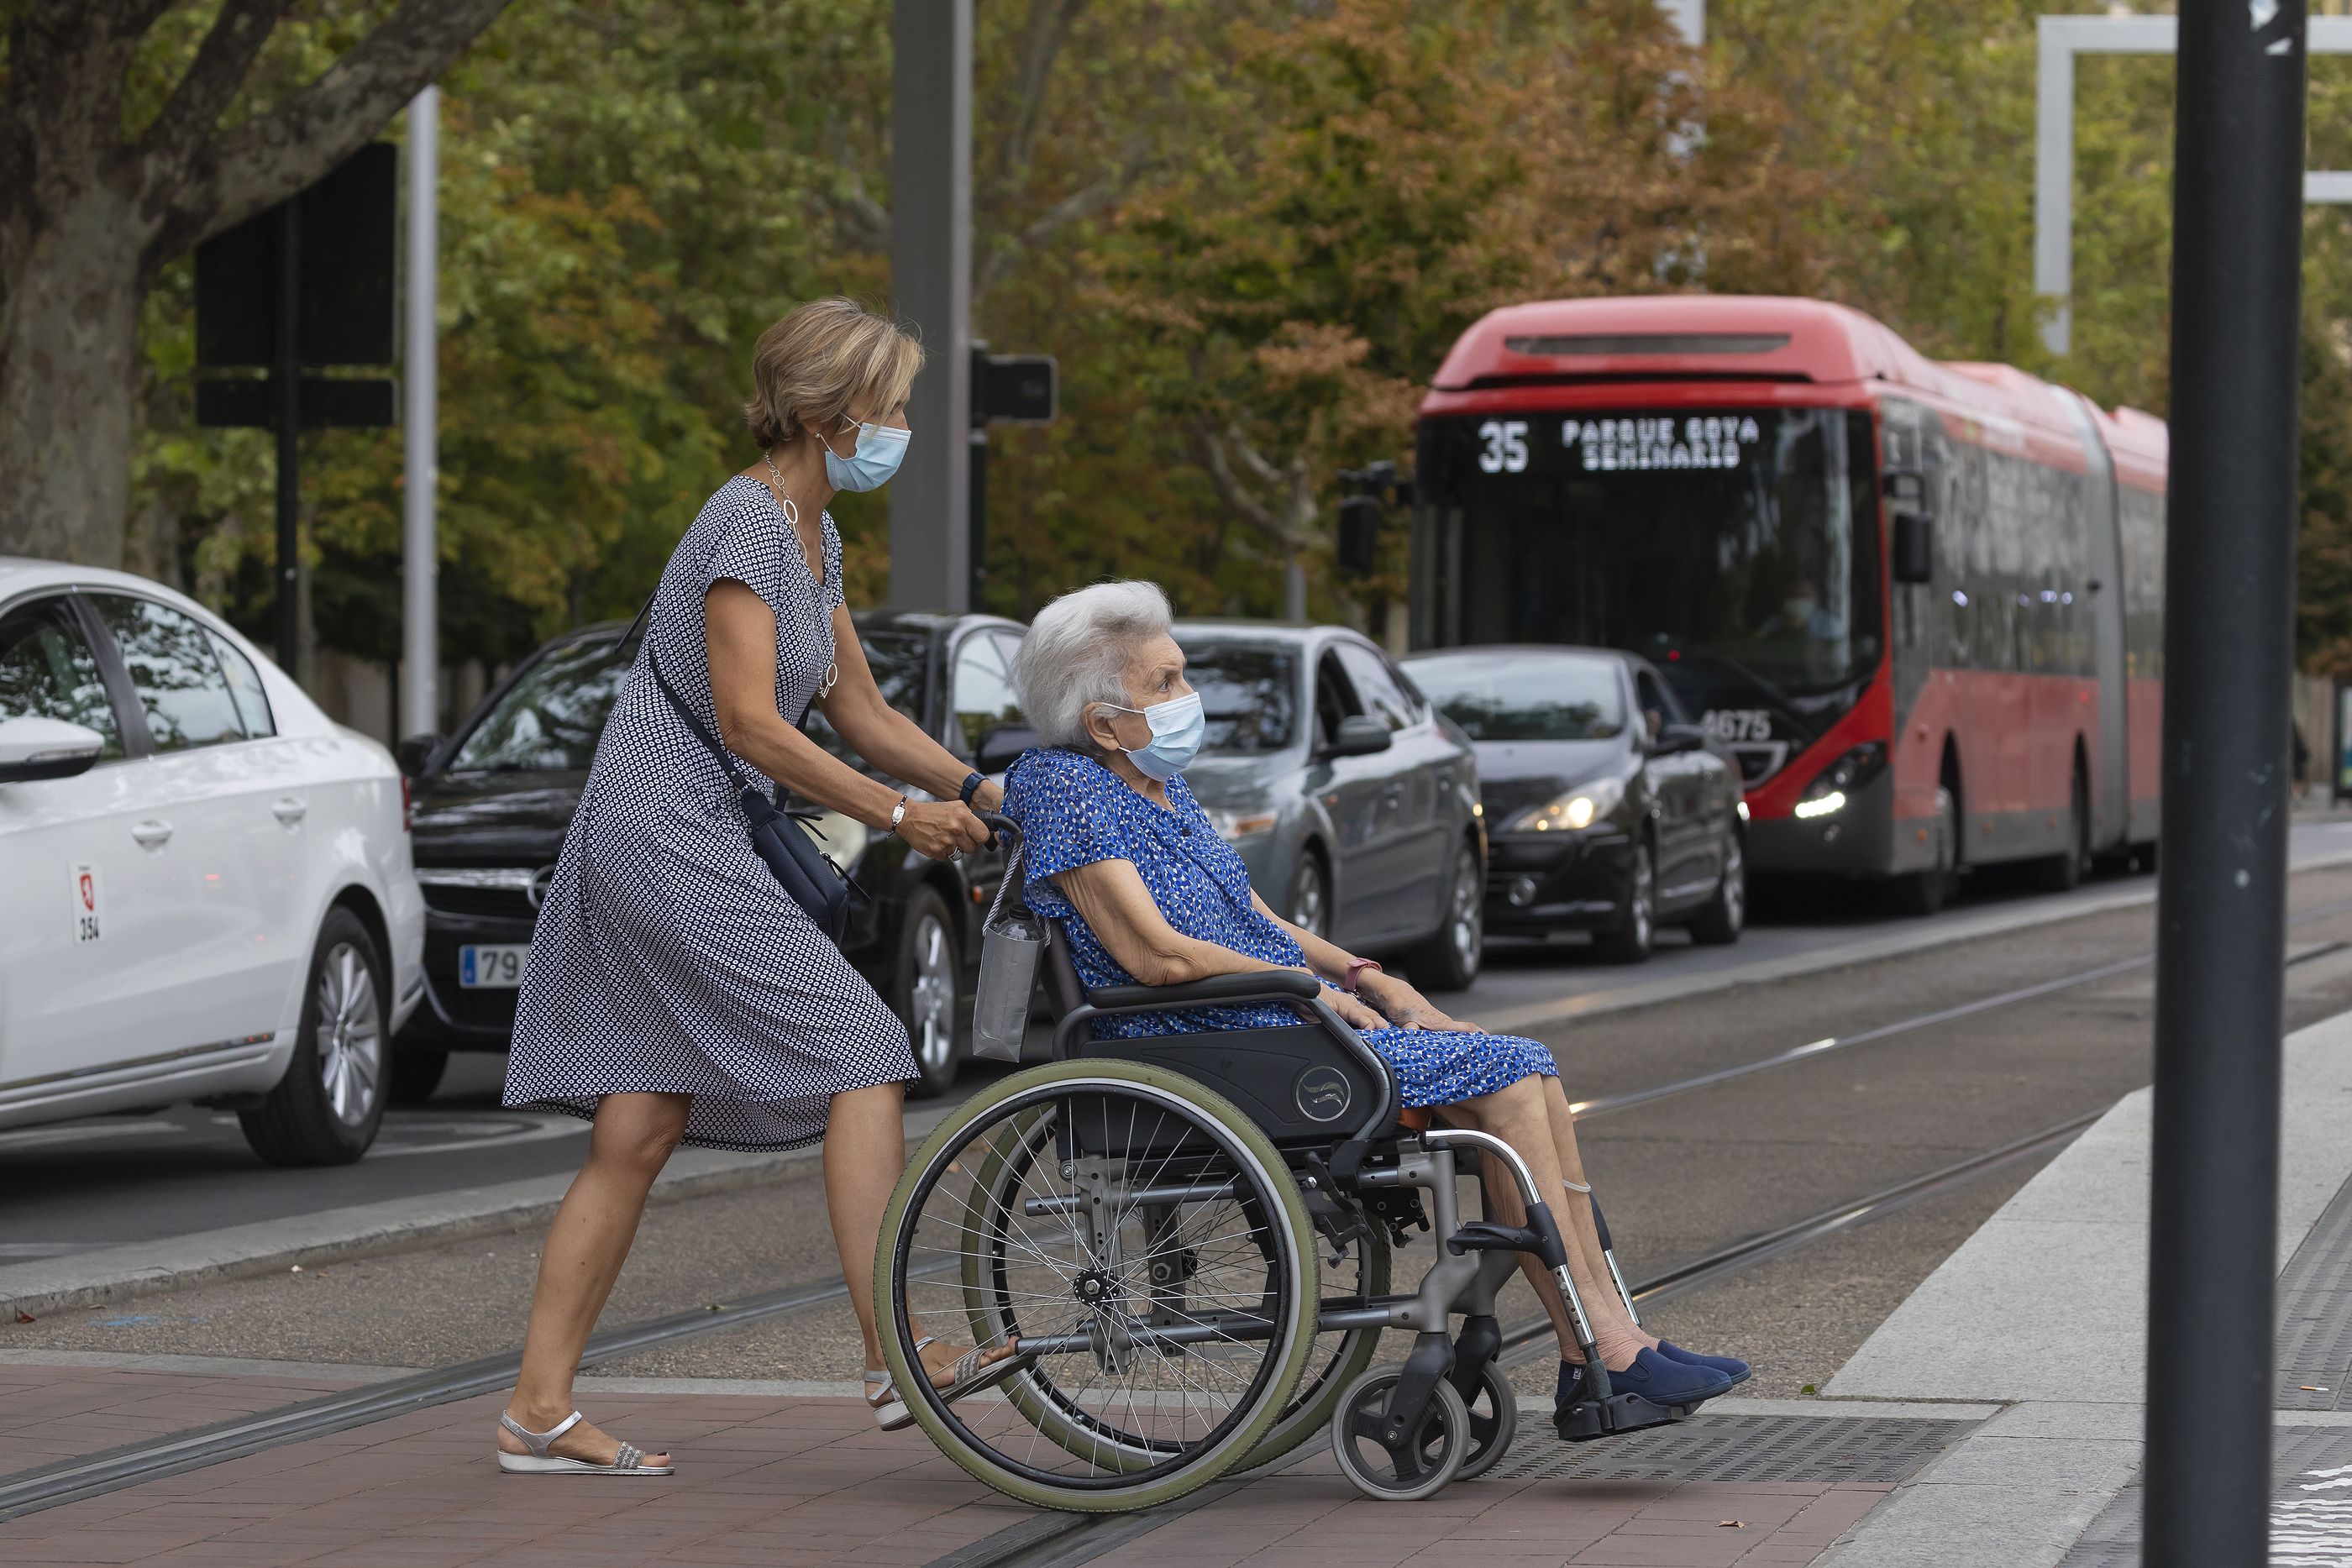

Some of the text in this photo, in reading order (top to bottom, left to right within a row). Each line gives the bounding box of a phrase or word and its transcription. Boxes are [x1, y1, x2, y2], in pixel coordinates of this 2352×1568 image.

[1478, 421, 1529, 473] 35
[1562, 417, 1760, 448] PARQUE GOYA
[1582, 441, 1740, 470] SEMINARIO
[1700, 709, 1772, 740] 4675
[80, 916, 99, 941] 354
